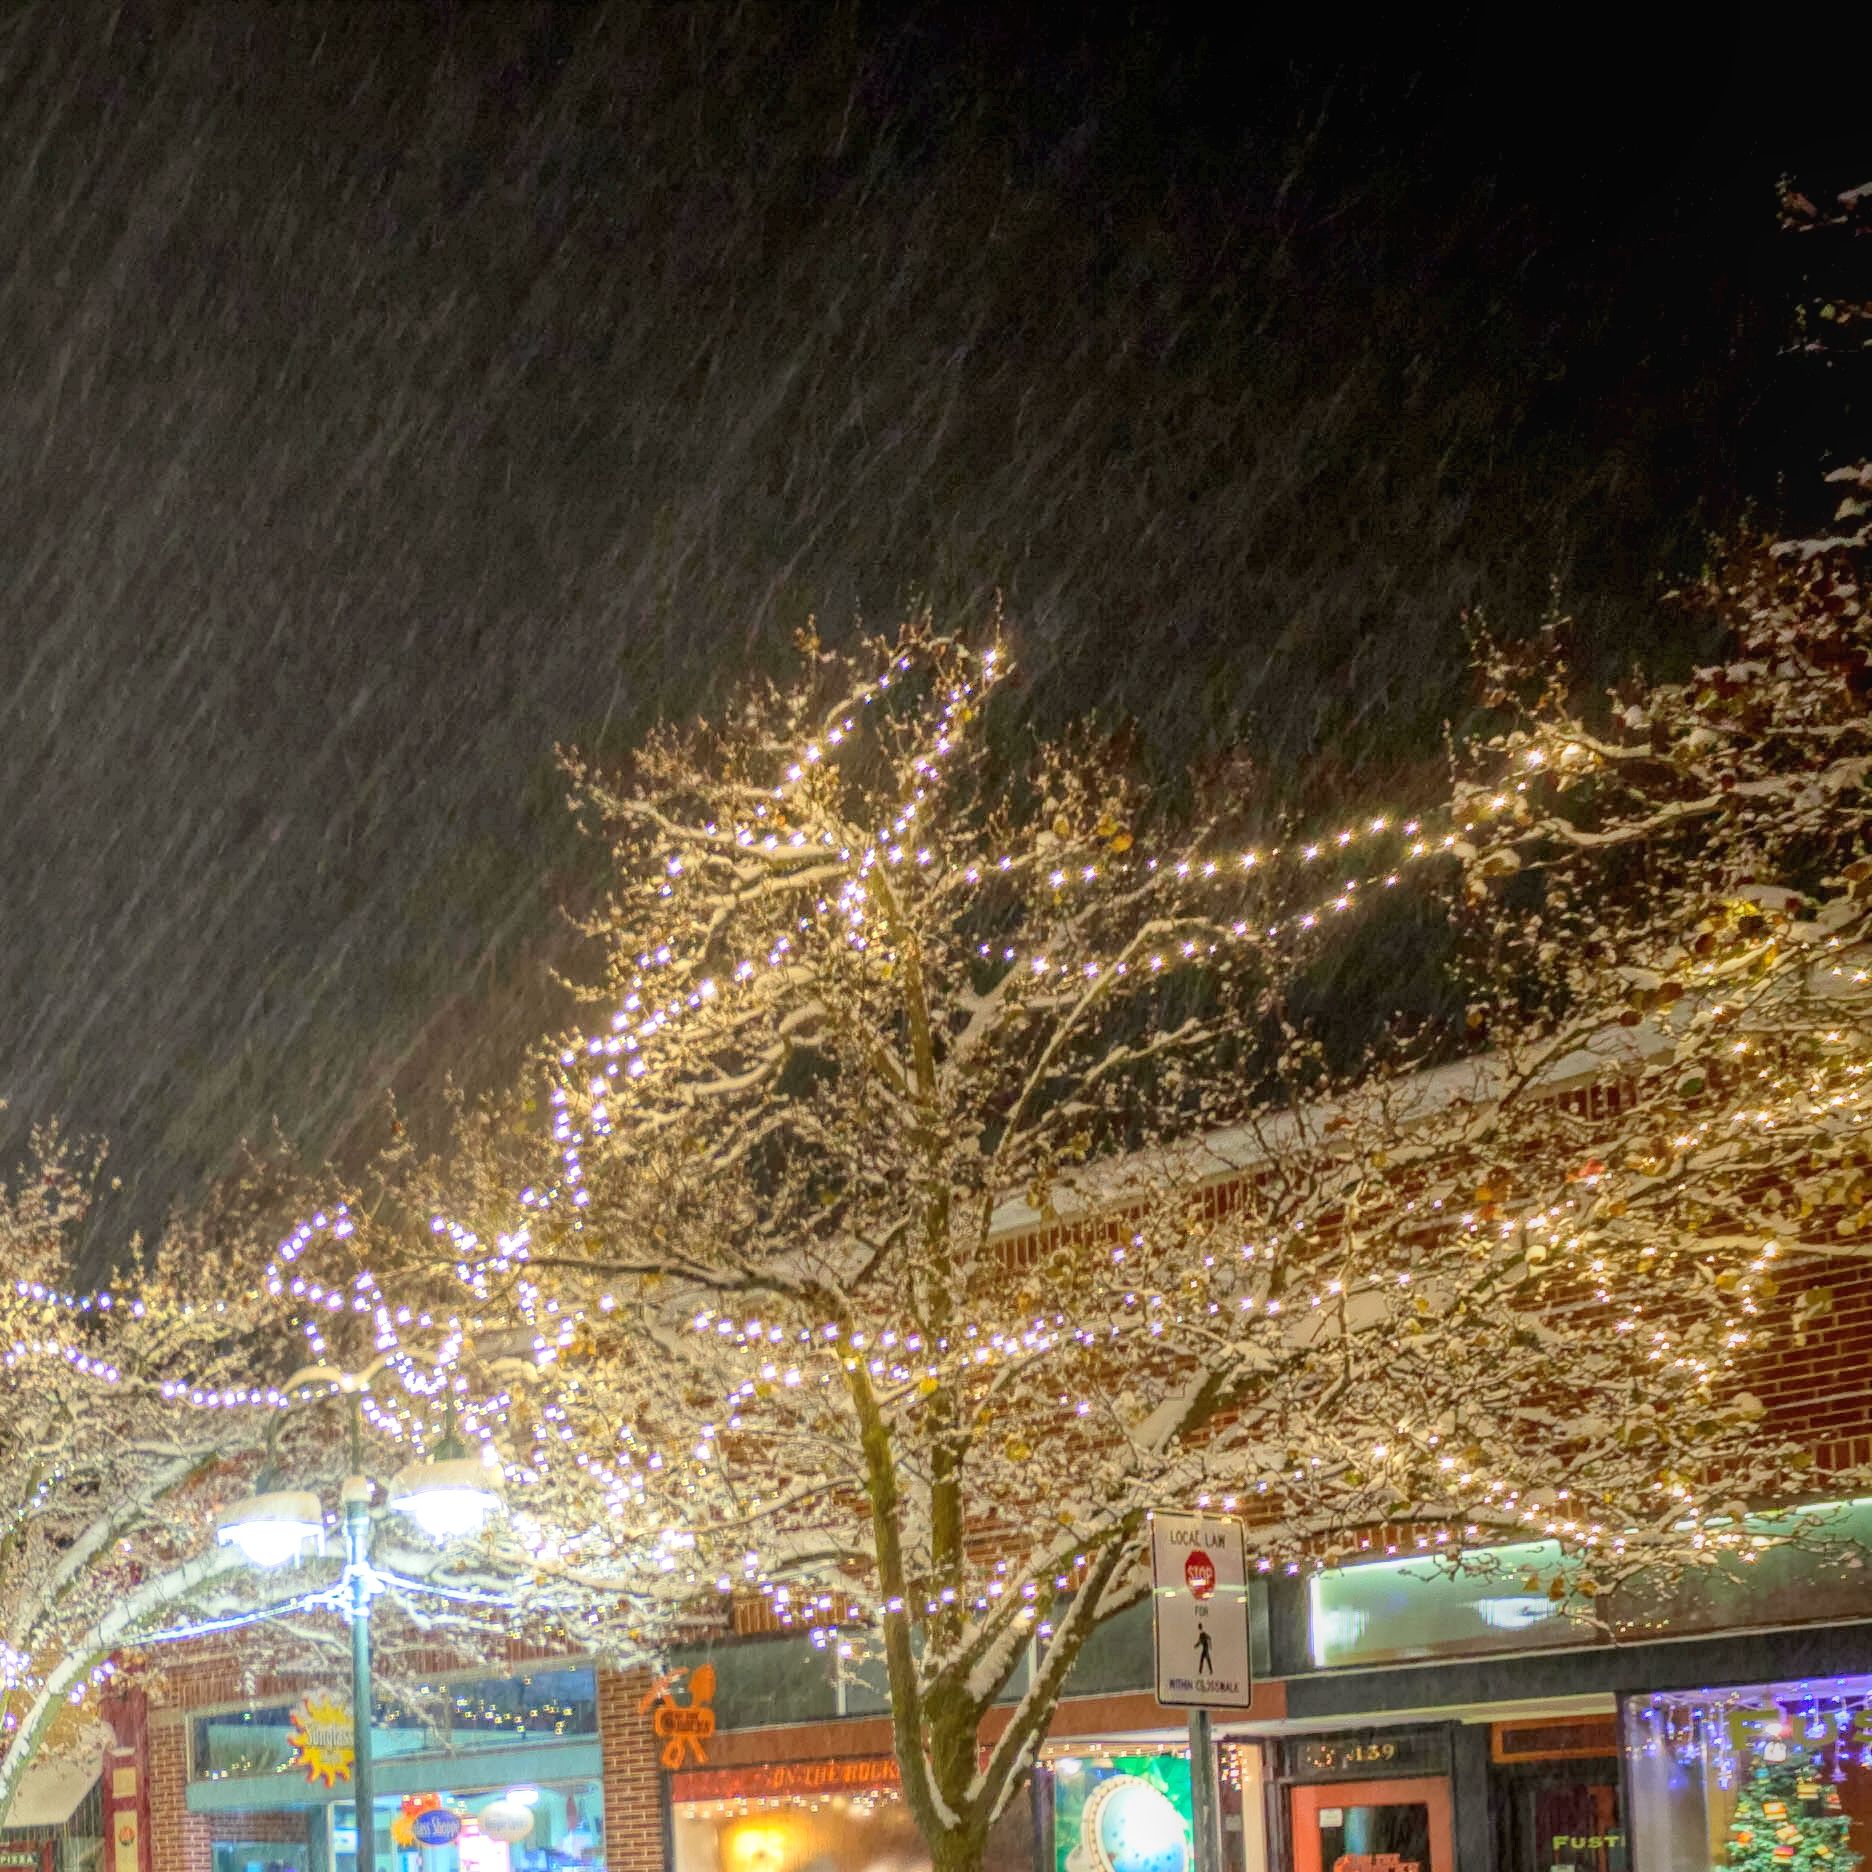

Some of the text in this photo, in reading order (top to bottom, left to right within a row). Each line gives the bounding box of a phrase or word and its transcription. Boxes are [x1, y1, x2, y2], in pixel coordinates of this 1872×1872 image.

[1170, 1530, 1226, 1549] LOCAL LAW
[1187, 1565, 1214, 1582] STOP
[0, 1854, 33, 1865] PIZZA
